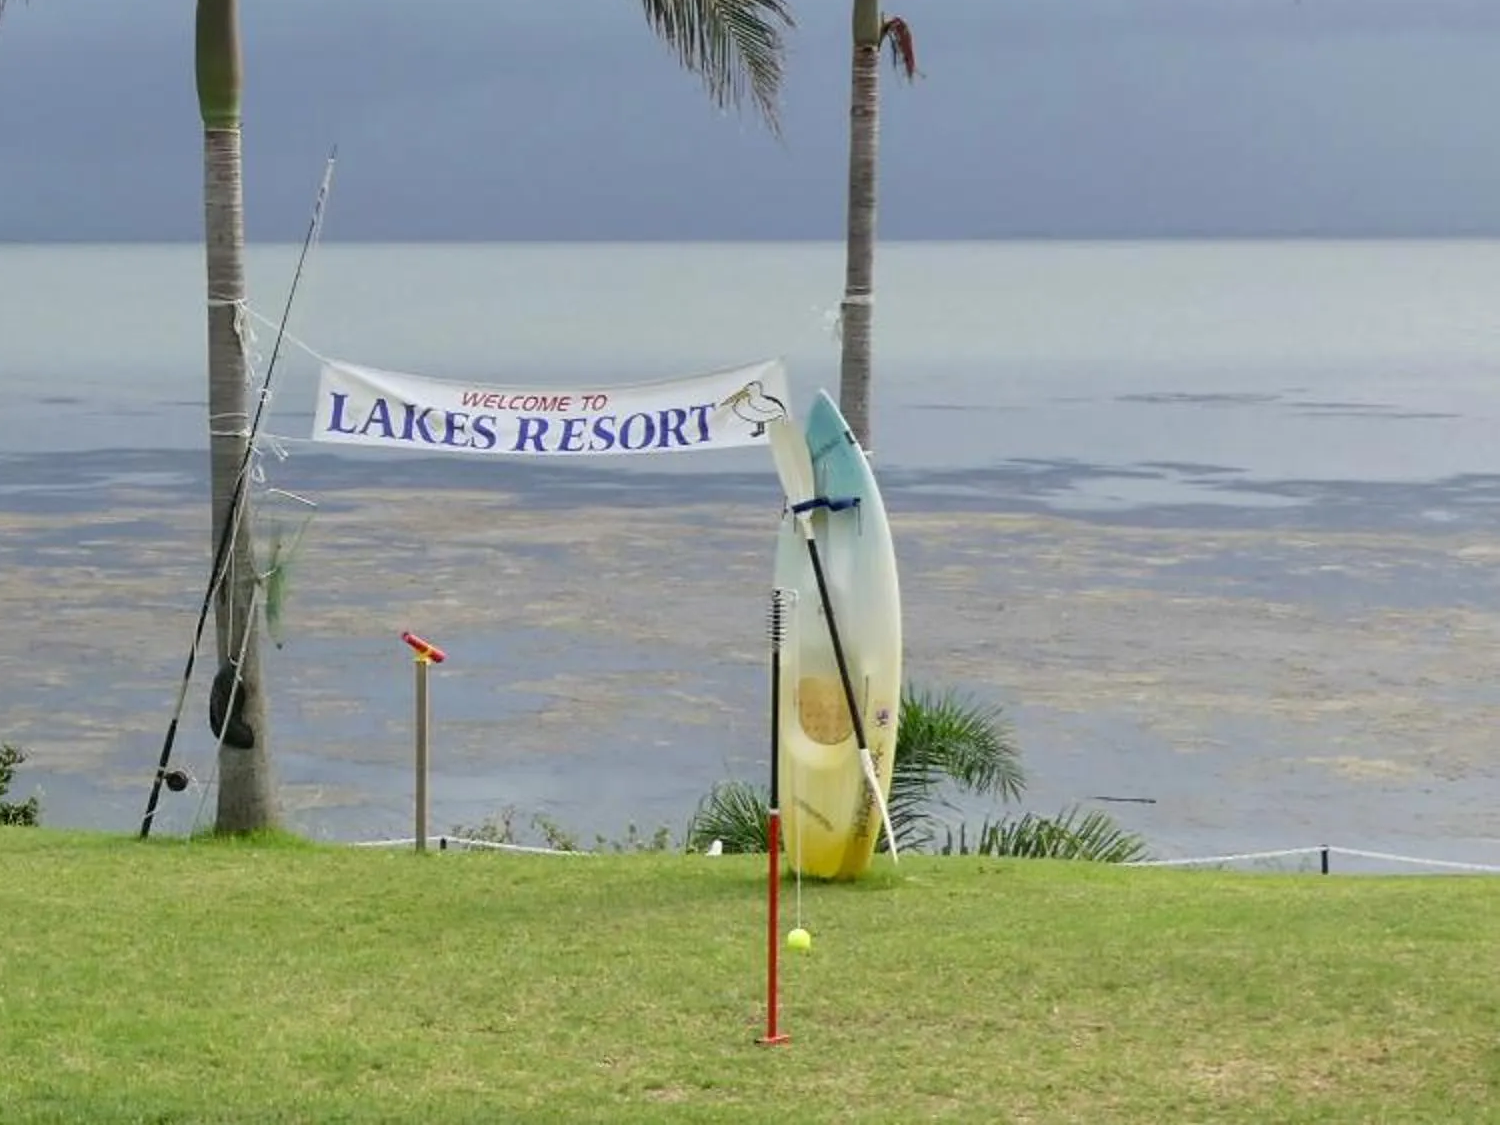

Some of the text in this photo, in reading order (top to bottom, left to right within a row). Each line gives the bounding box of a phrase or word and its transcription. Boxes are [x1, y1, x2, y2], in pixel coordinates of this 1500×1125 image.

[326, 391, 717, 452] LAKES RESORT
[461, 391, 609, 412] WELCOME TO
